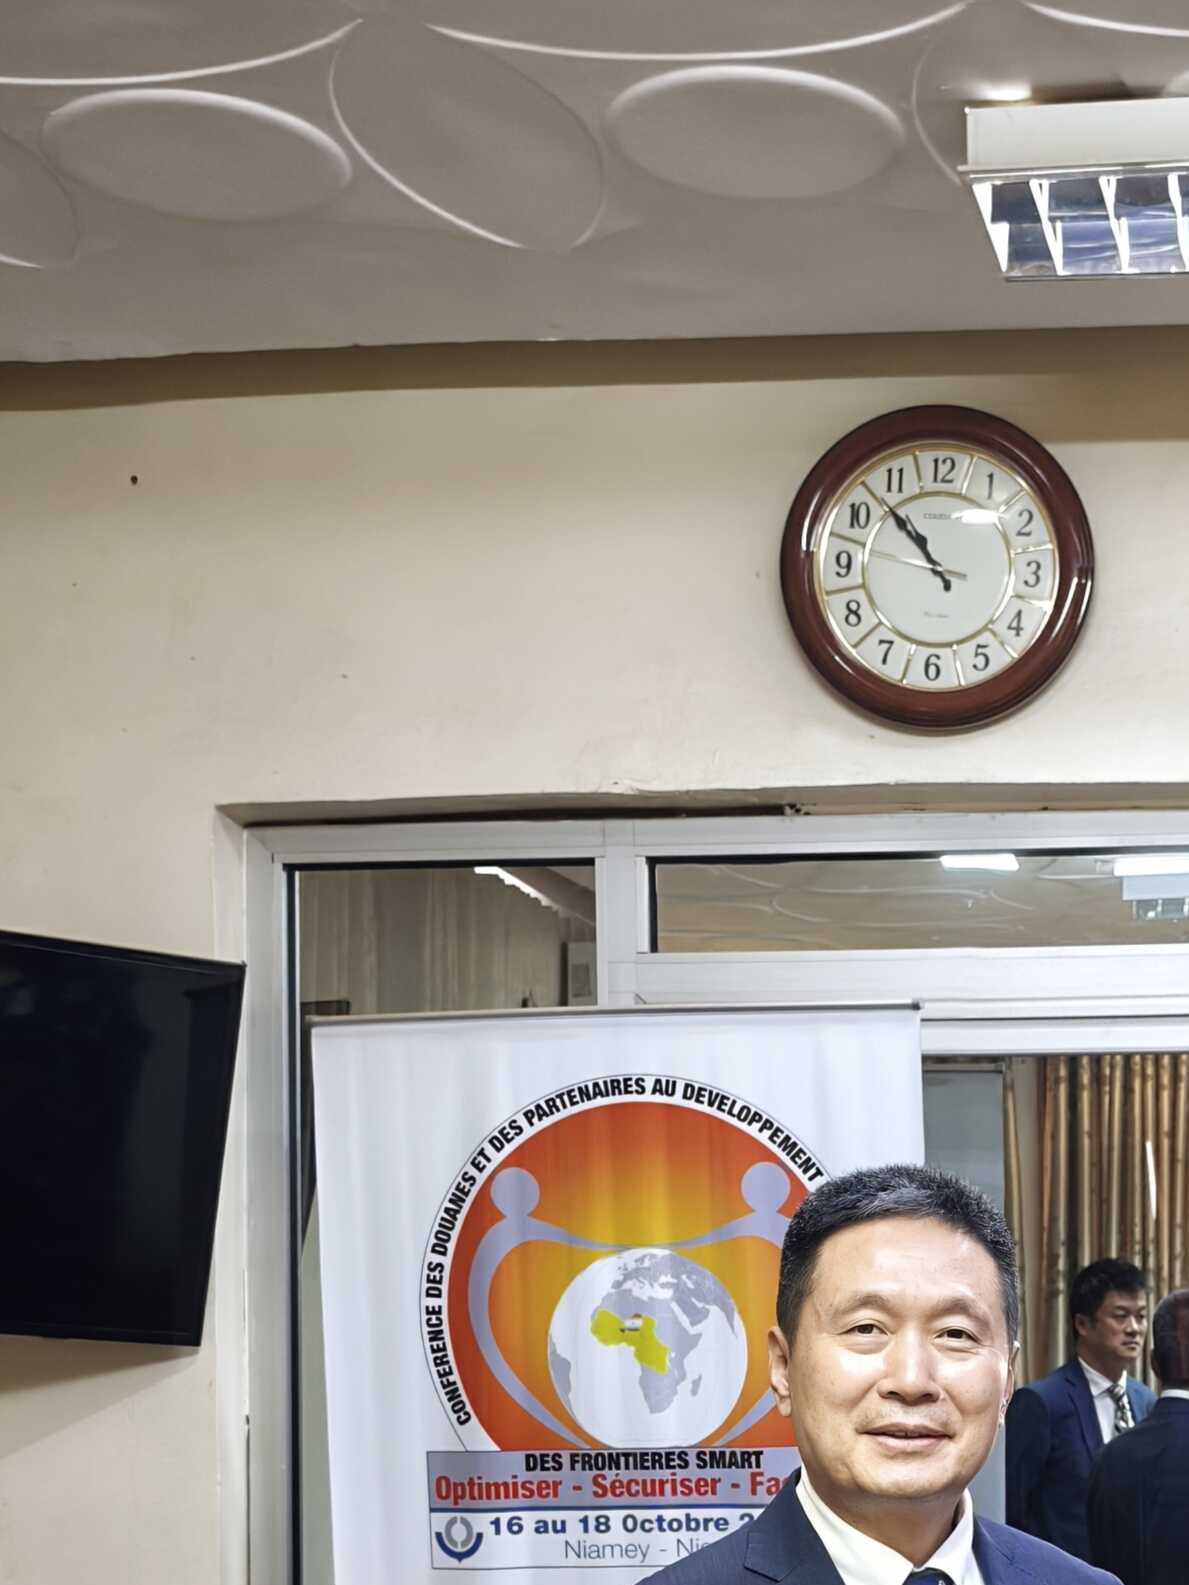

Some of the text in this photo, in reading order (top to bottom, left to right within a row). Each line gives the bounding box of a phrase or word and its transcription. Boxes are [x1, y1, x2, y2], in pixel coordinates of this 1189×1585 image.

[885, 468, 904, 493] 11
[932, 457, 956, 483] 12
[986, 473, 994, 499] 1
[848, 502, 870, 529] 10
[1016, 510, 1033, 536] 2
[835, 550, 852, 577] 9
[1023, 561, 1041, 587] 3
[844, 600, 861, 627] 8
[1007, 609, 1024, 637] 4
[877, 640, 894, 665] 7
[972, 644, 990, 671] 5
[923, 653, 941, 680] 6
[425, 1077, 824, 1426] CONFERENCE DES DOUANES ET DES PARTENAIRES AU DEVELOPPEMENT
[524, 1450, 764, 1472] DES FRONTIERES SMART
[435, 1475, 563, 1507] Optimiser
[592, 1472, 721, 1498] Sécuriser
[750, 1471, 790, 1497] Fa
[489, 1516, 524, 1536] 16
[534, 1520, 567, 1535] au
[579, 1515, 611, 1535] 18
[622, 1513, 729, 1533] Octobre
[564, 1539, 650, 1563] Niamey
[677, 1538, 709, 1557] Ni
